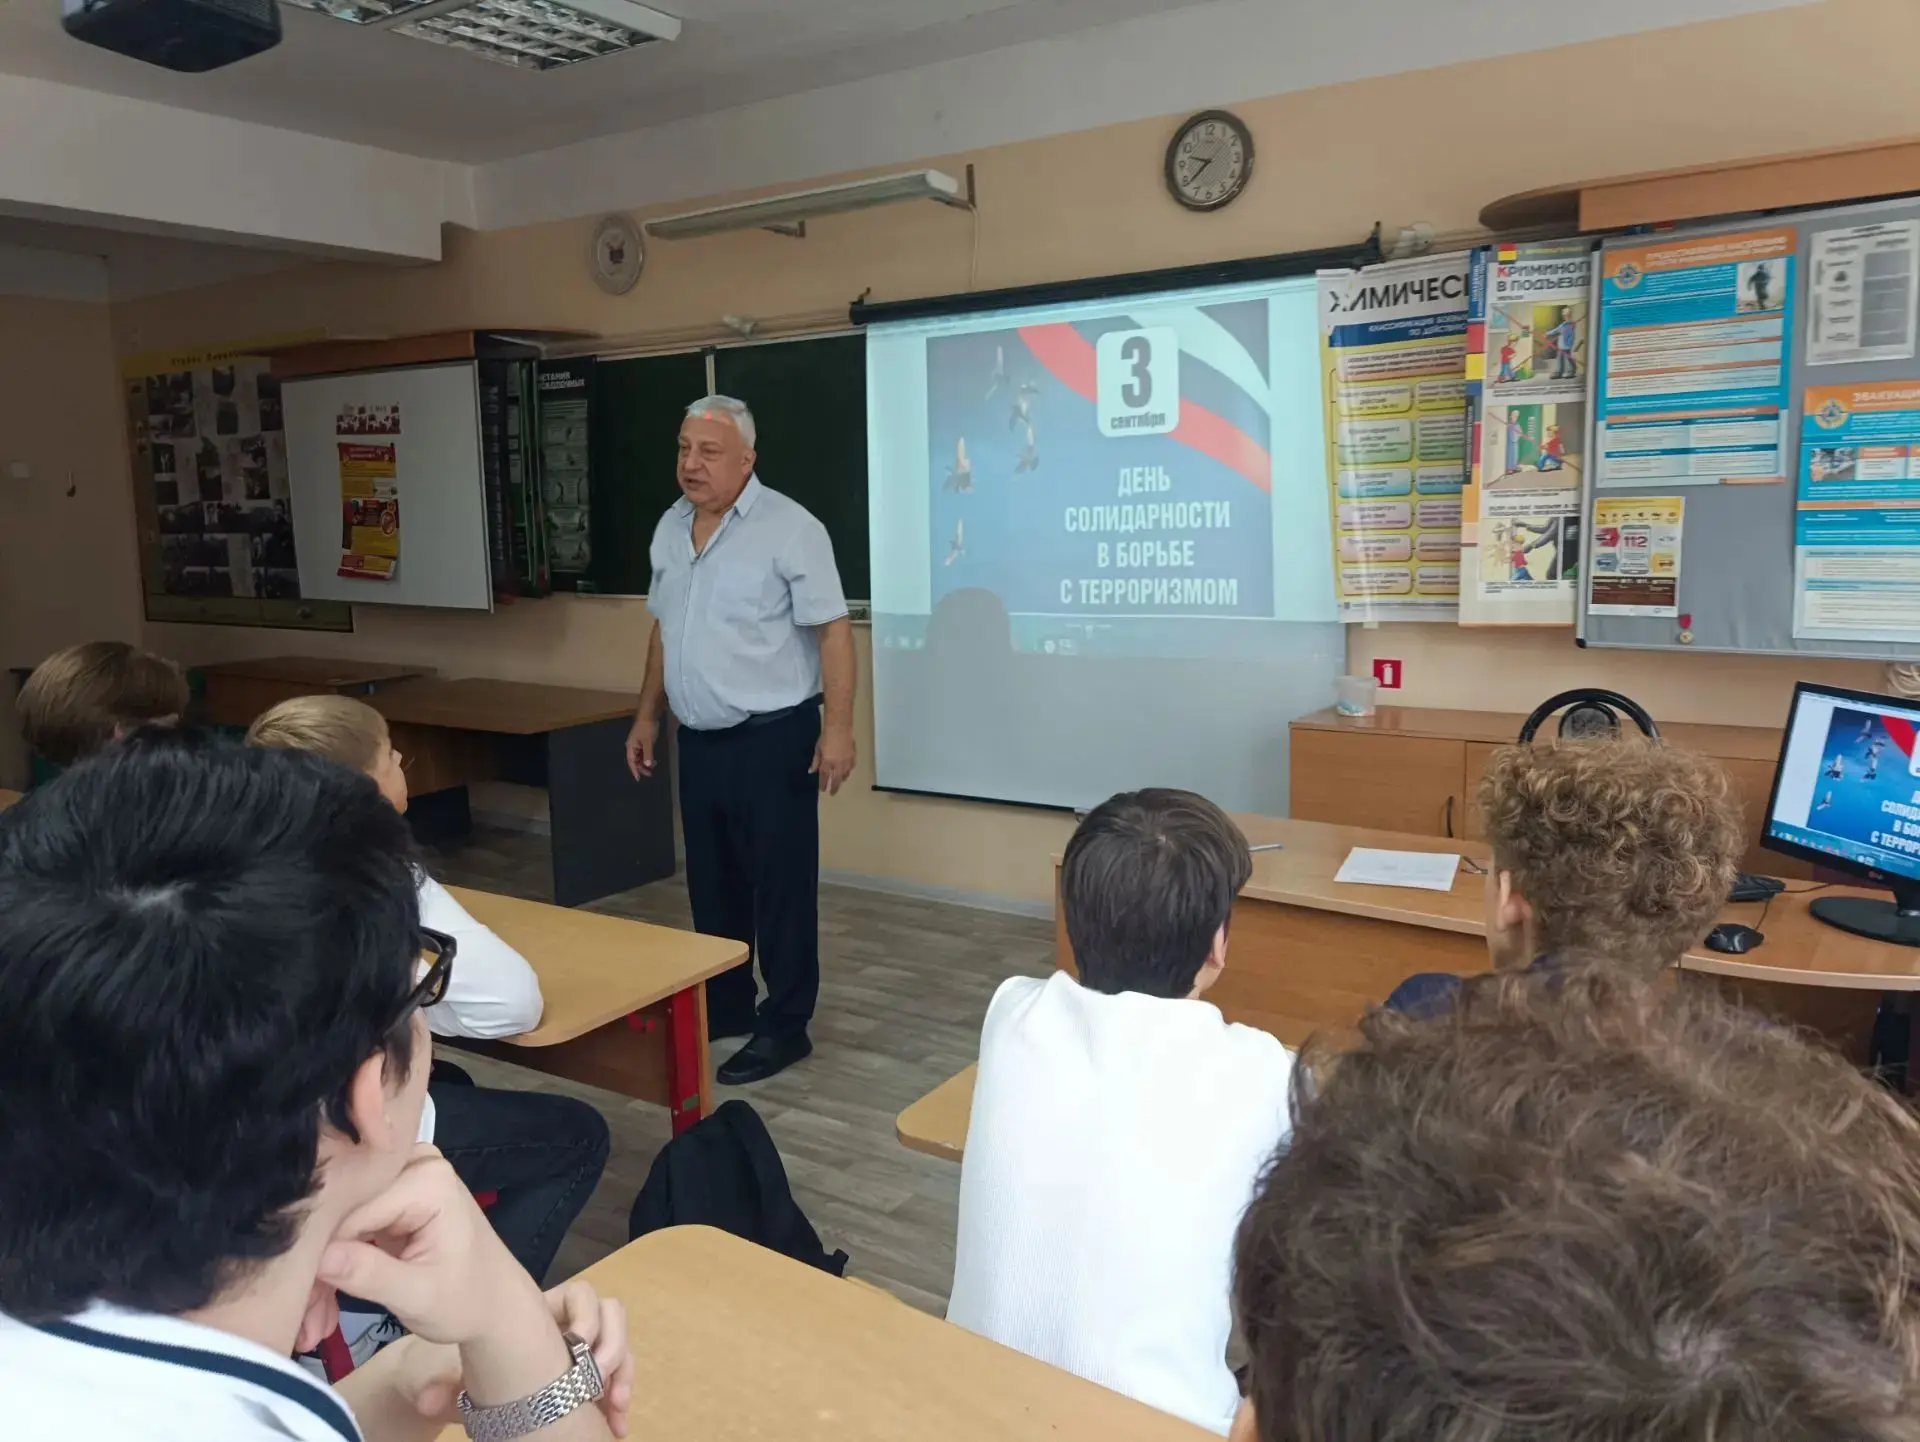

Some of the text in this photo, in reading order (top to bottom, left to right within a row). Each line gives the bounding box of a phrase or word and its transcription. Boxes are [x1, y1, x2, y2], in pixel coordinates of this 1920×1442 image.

[1205, 123, 1216, 135] 12
[1230, 134, 1238, 146] 2
[1234, 153, 1240, 163] 3
[1178, 160, 1185, 171] 9
[1228, 168, 1236, 179] 4
[1192, 186, 1201, 198] 7
[1219, 181, 1228, 193] 5
[1205, 191, 1213, 200] 6
[1497, 280, 1507, 293] В
[1121, 336, 1152, 408] 3
[1110, 412, 1166, 430] сентября
[1118, 465, 1171, 497] ДЕНЬ
[1064, 500, 1231, 533] СОЛИДАРНОСТИ
[1623, 536, 1649, 548] 112
[1097, 539, 1195, 568] В БОРЬБЕ
[1060, 577, 1239, 606] С ТЕРРОРИЗМОМ
[1892, 819, 1902, 833] В
[1870, 830, 1880, 843] С
